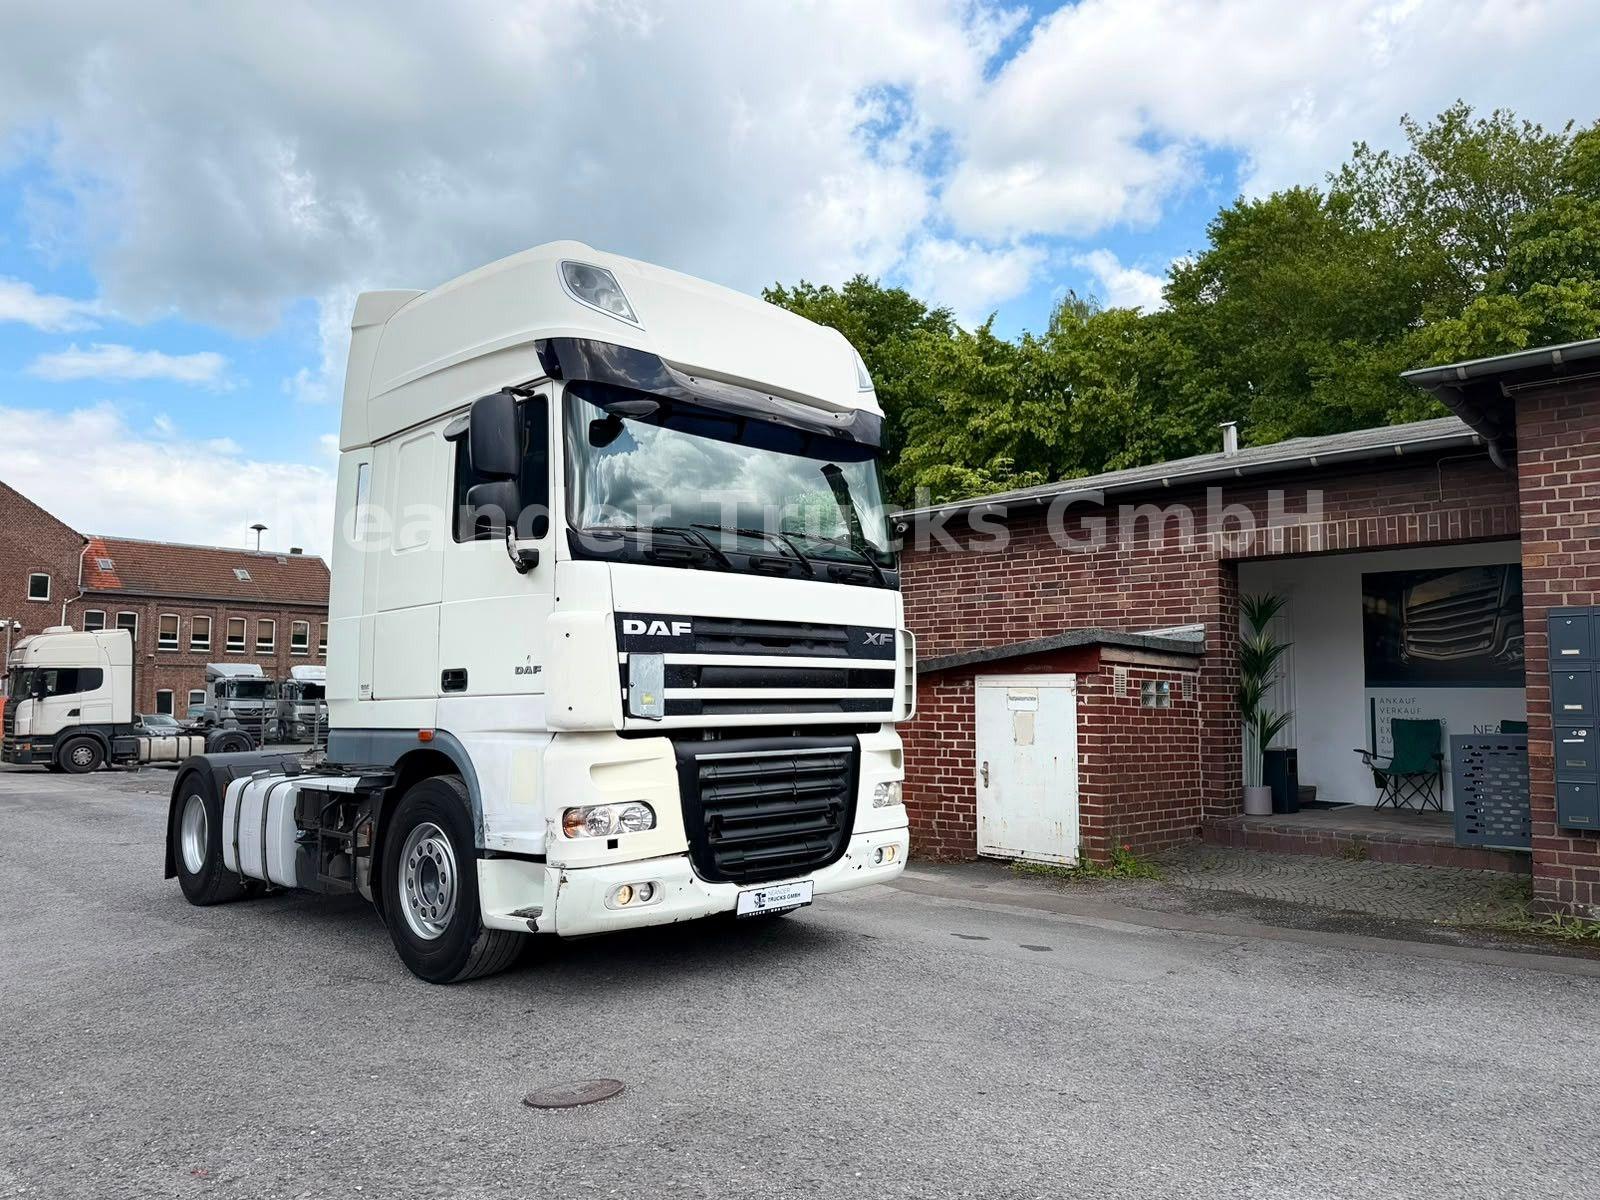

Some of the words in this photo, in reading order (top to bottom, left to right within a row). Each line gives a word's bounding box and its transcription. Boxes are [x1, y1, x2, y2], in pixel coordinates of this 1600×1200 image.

[623, 620, 692, 636] DAF
[863, 632, 893, 645] XF
[515, 665, 542, 675] DAF
[1379, 697, 1417, 705] ANKAUF
[1380, 706, 1422, 715] VERKAUF
